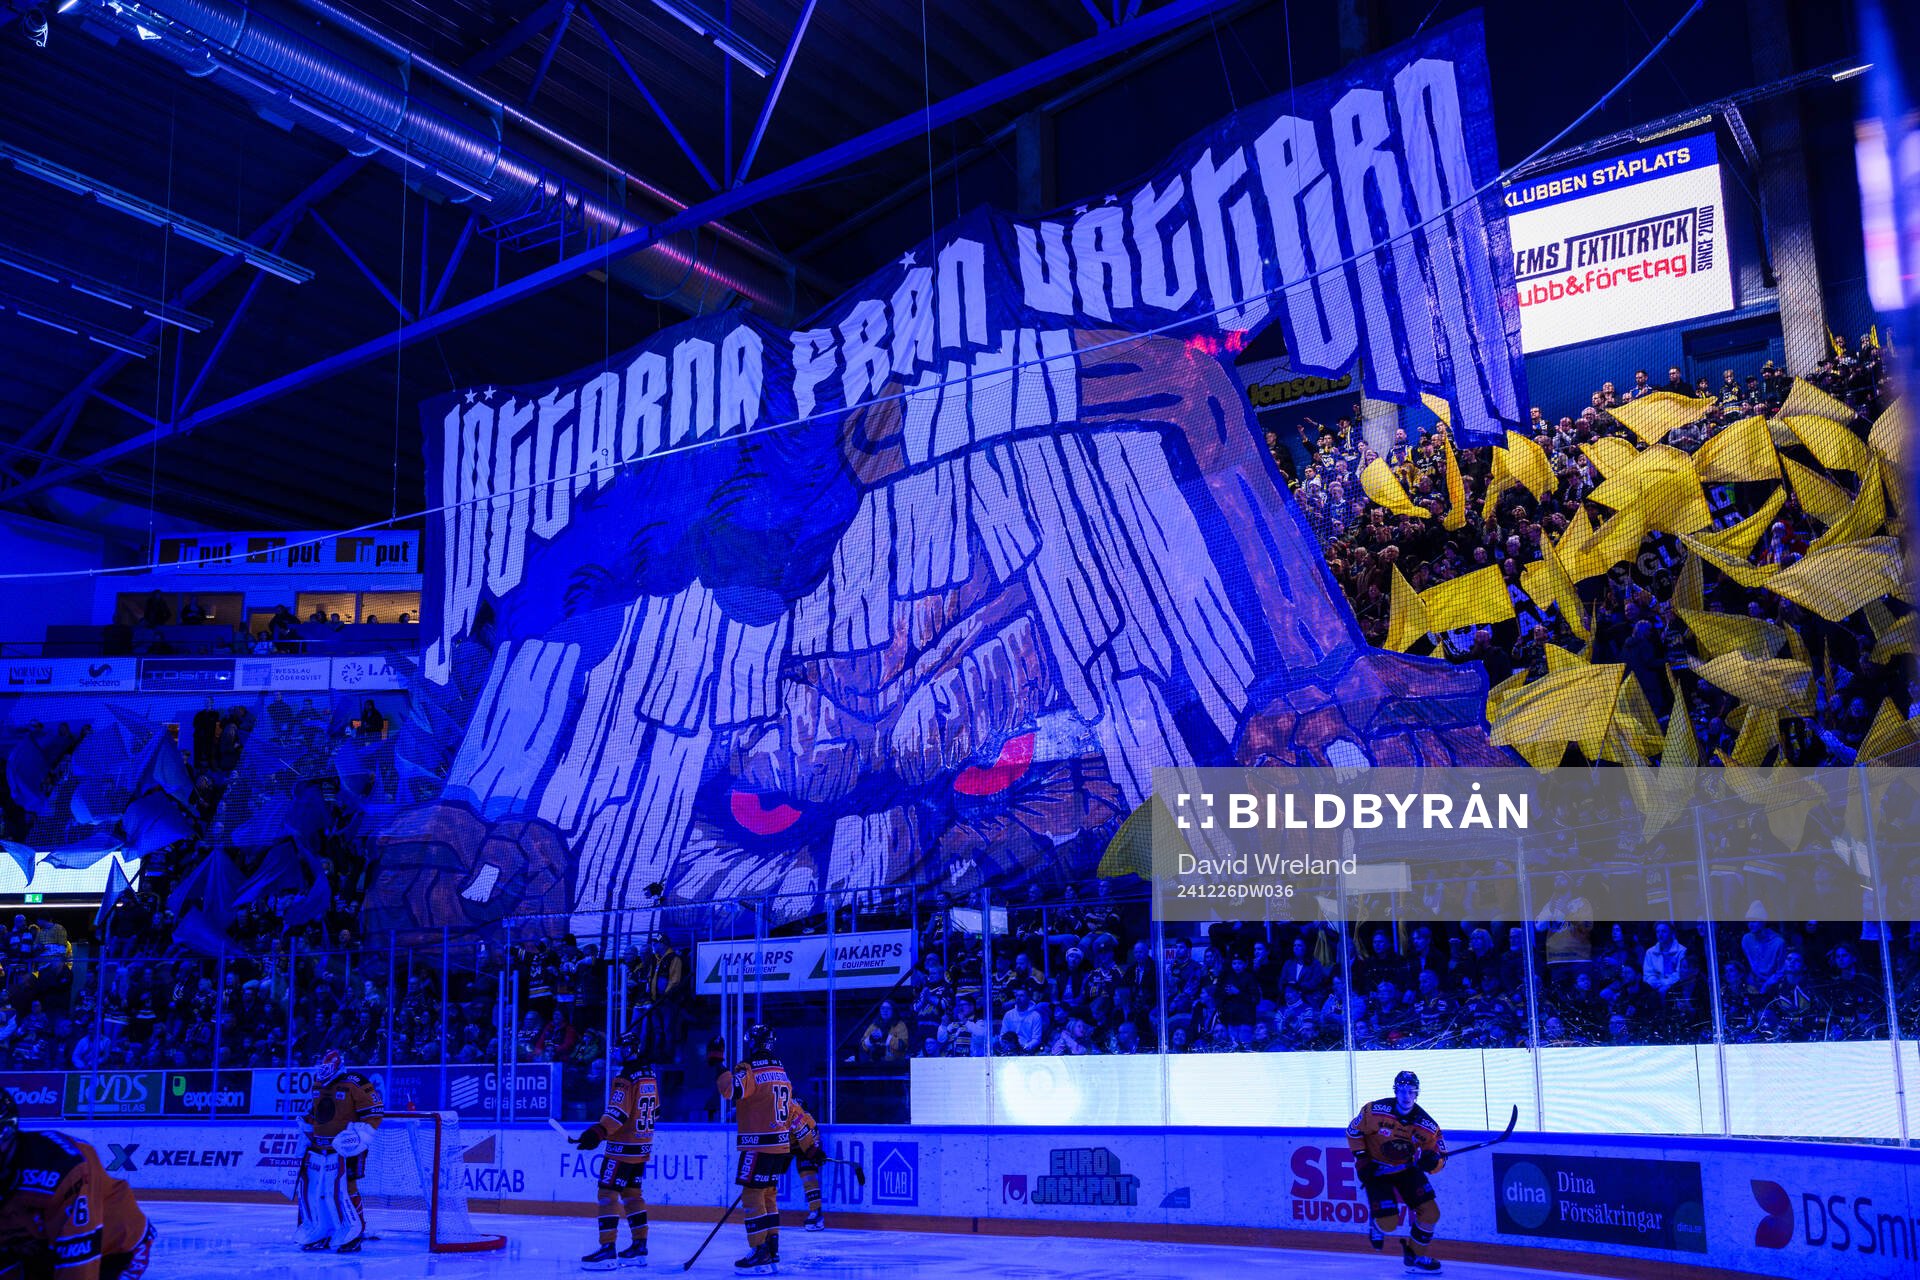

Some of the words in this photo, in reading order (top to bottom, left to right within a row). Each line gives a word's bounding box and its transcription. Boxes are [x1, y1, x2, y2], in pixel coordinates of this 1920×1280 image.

[1592, 147, 1691, 186] STÅPLATS
[1699, 205, 1714, 237] 2000
[1563, 214, 1689, 272] TEXTILTRYCK
[1698, 238, 1714, 271] SINCE
[790, 237, 988, 418] FRÅN
[842, 960, 885, 969] EQUIPMENT
[277, 1072, 317, 1094] CEO
[484, 1072, 547, 1090] Gänna
[530, 1097, 547, 1109] AB
[636, 1096, 656, 1132] 33
[773, 1085, 790, 1123] 13
[1372, 1104, 1393, 1113] SSAB
[640, 1145, 652, 1154] SSA
[741, 1135, 760, 1145] SSAB
[778, 1133, 790, 1143] SSA
[144, 1151, 243, 1167] AXELENT
[560, 1153, 708, 1181] FAHULT
[1050, 1149, 1109, 1176] EURO
[22, 1169, 61, 1188] SSAB
[884, 1171, 908, 1195] YLAB
[1290, 1146, 1358, 1201] SE
[1557, 1171, 1596, 1195] Dina
[1032, 1175, 1137, 1205] JACKPOT
[1506, 1181, 1547, 1205] dina
[1559, 1200, 1663, 1233] Försäkringar
[1854, 1196, 1920, 1262] Smi
